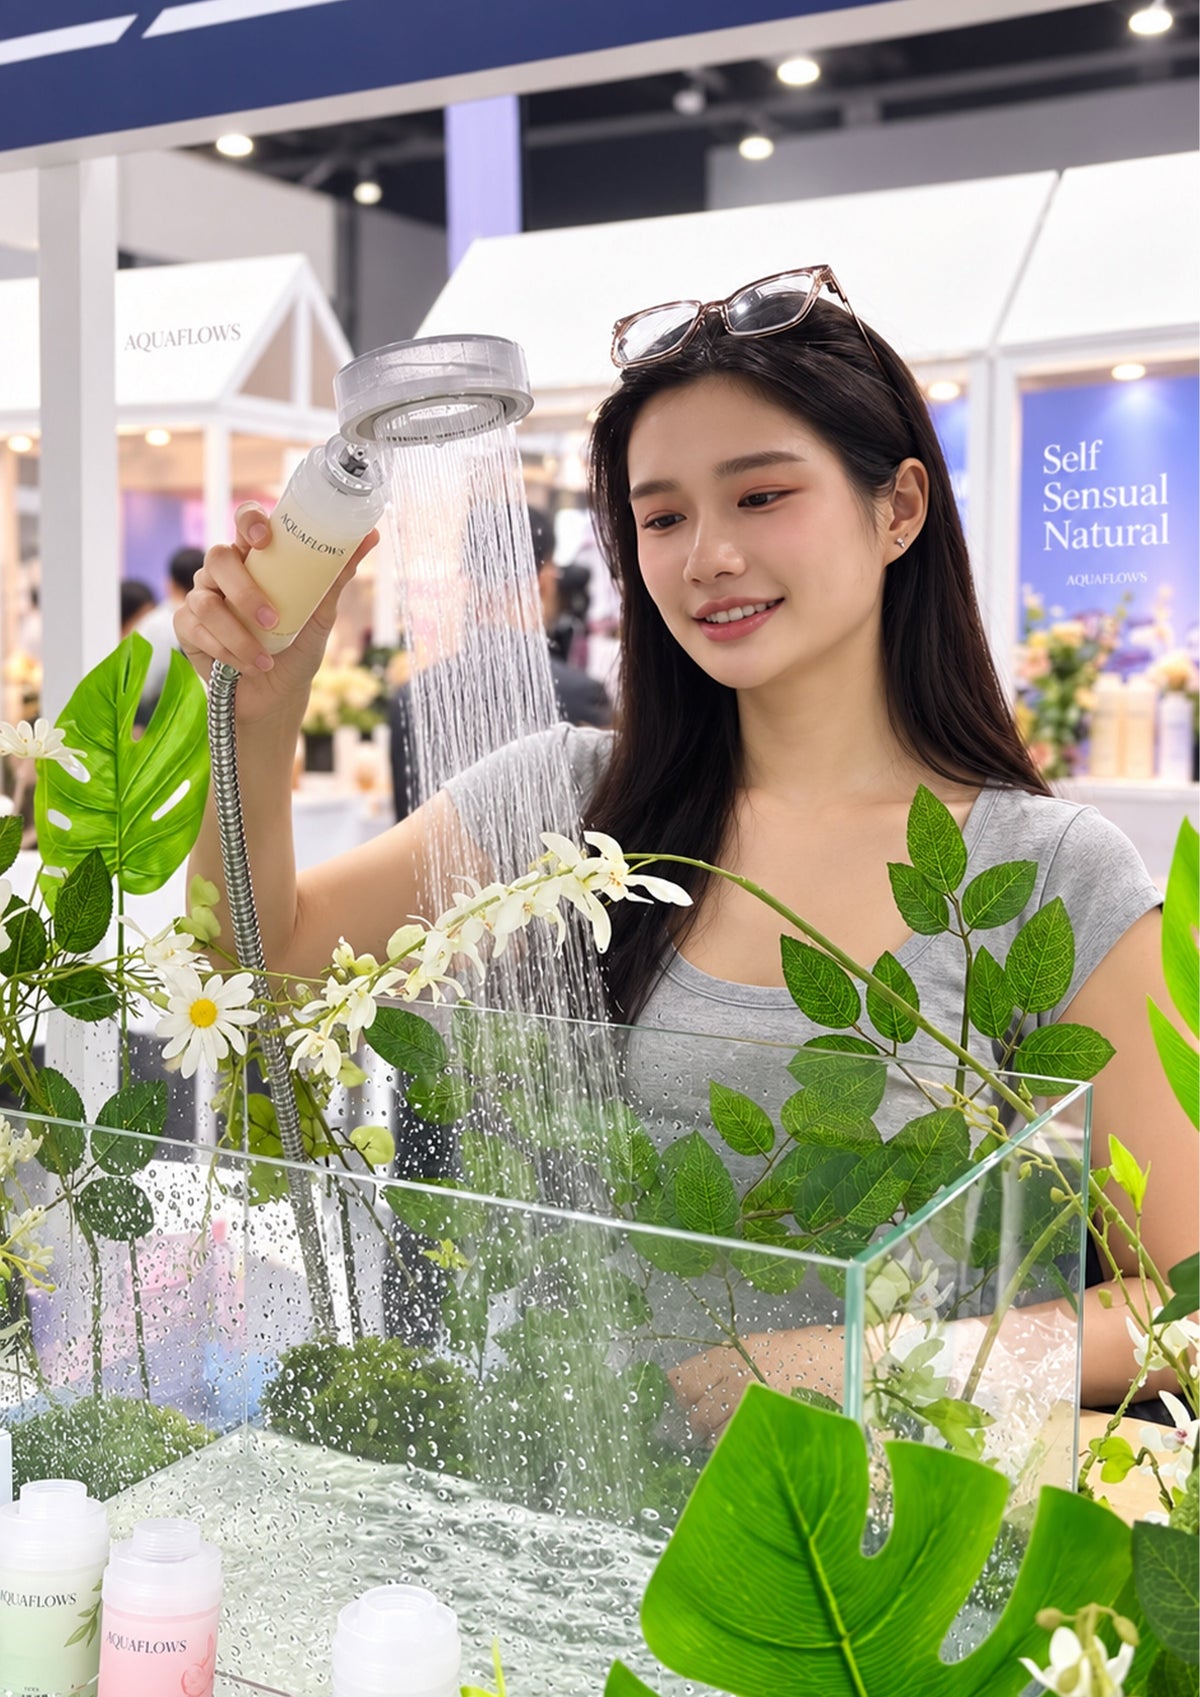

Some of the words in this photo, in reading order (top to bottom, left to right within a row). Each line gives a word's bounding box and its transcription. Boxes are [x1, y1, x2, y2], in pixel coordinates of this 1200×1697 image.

[124, 322, 241, 353] AQUAFLOWS
[1043, 439, 1103, 474] Self
[1043, 472, 1169, 512] Sensual
[280, 512, 346, 556] AQUAFLOWS
[1043, 512, 1170, 551] Natural
[1065, 571, 1148, 587] AQUAFLOWS
[106, 1631, 187, 1654] AQUAFLOWS
